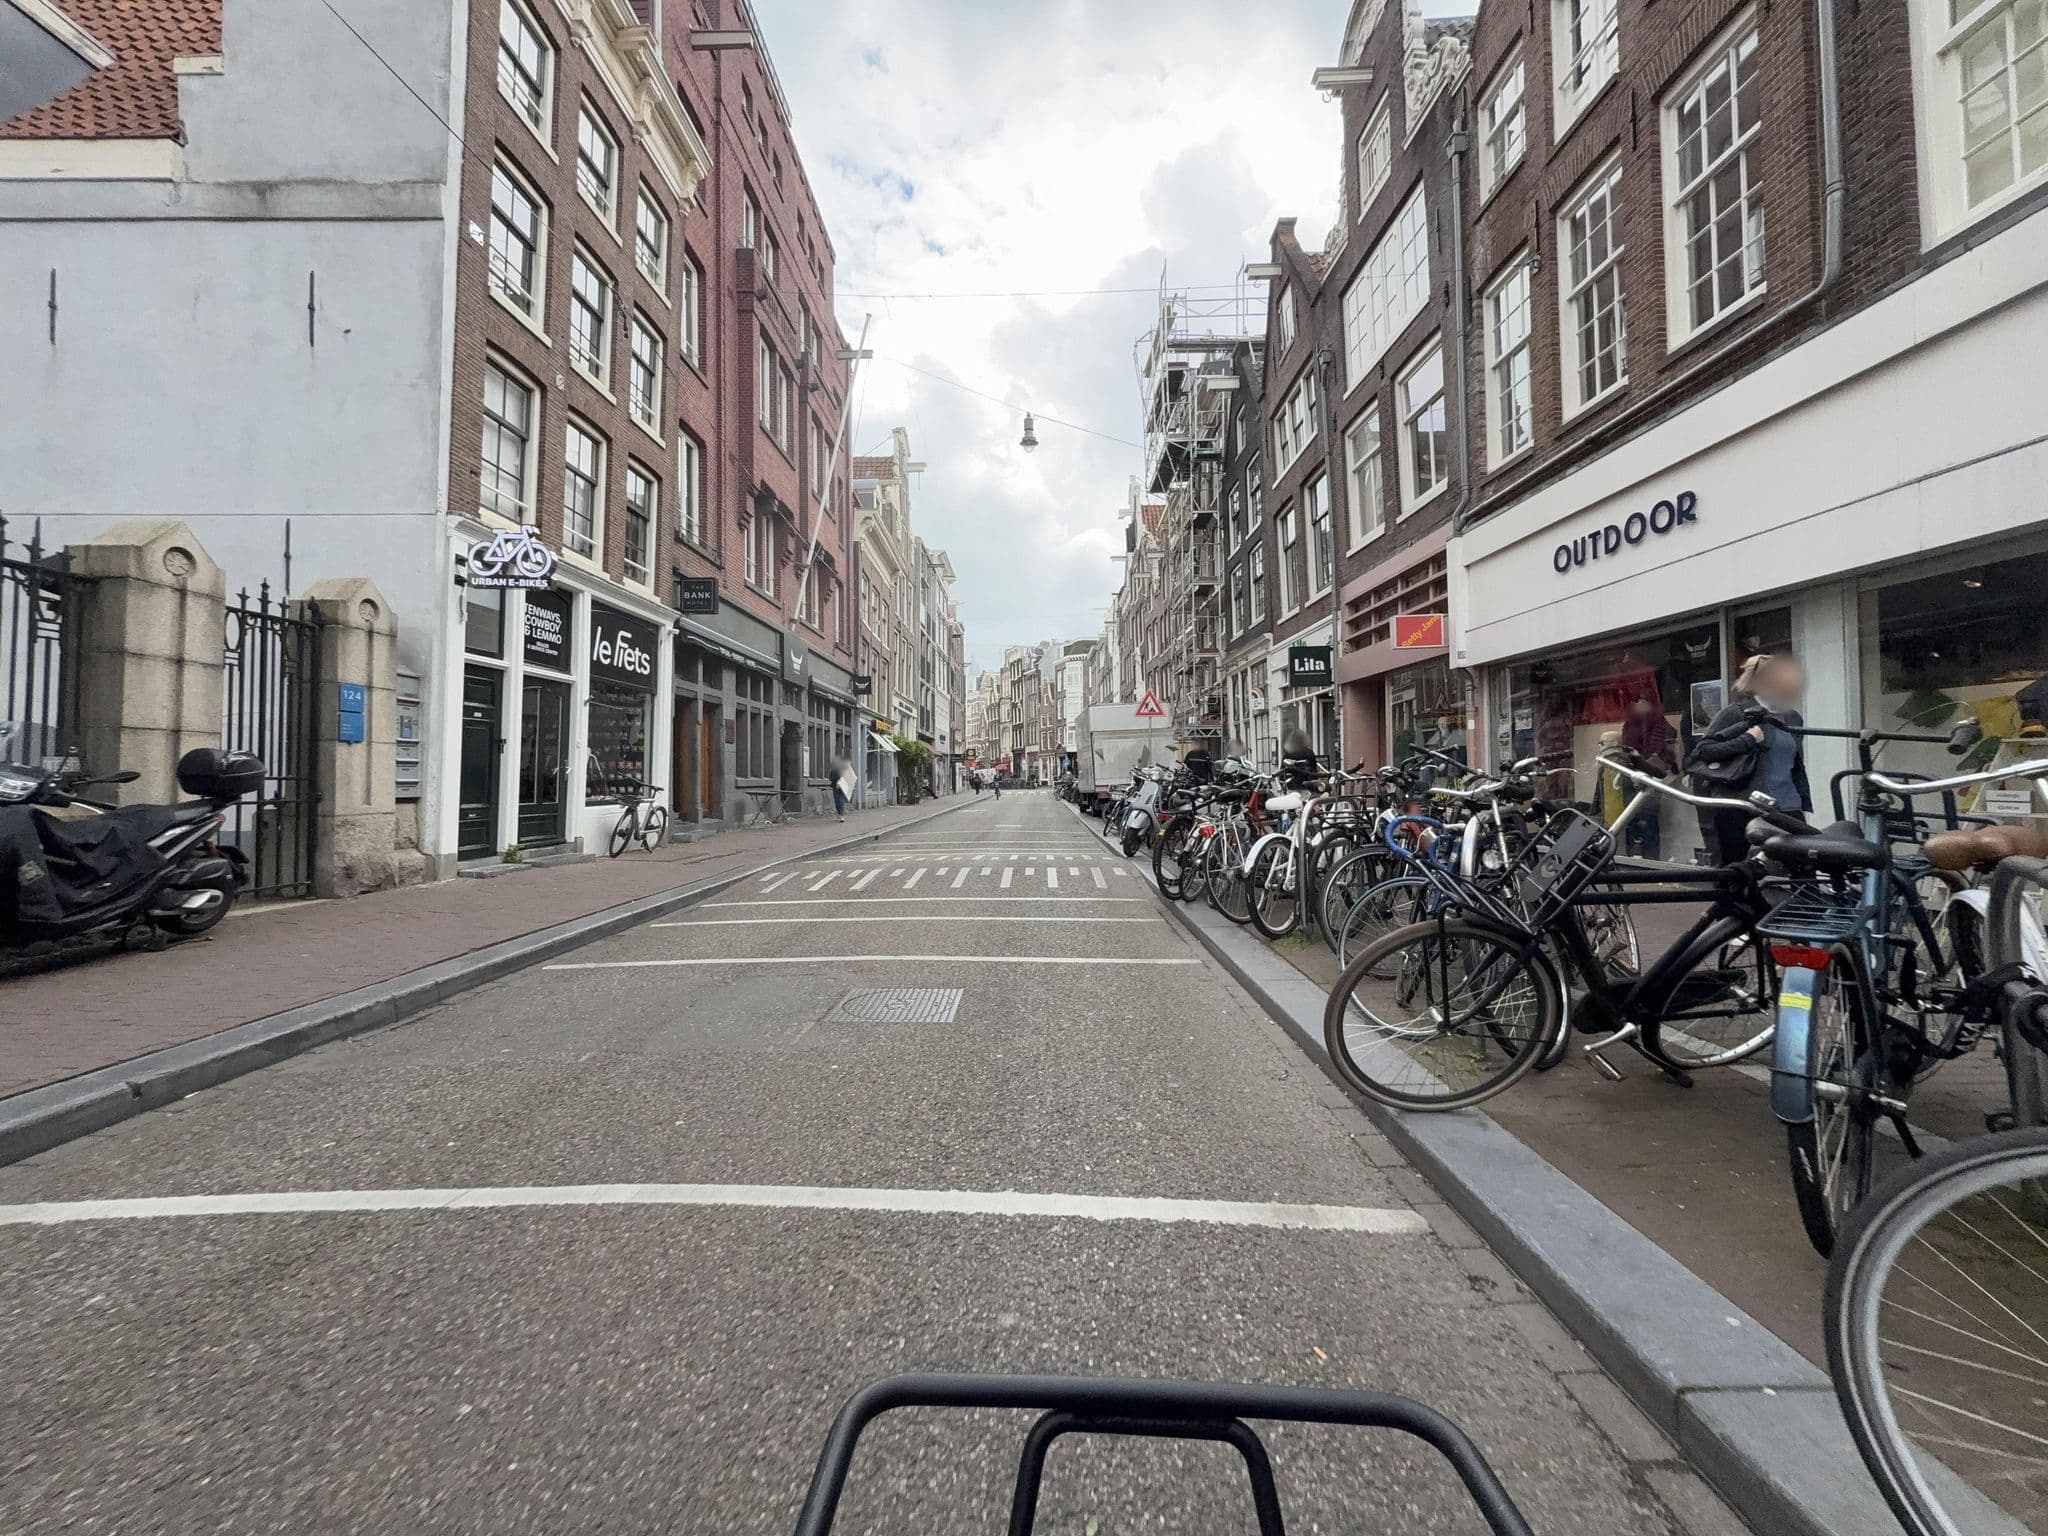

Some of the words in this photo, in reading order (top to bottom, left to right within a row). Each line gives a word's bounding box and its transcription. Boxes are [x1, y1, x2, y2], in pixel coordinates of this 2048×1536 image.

[1553, 490, 1697, 573] OUTDOOR
[471, 577, 506, 586] URBAN
[508, 579, 548, 587] E-BIKES
[683, 591, 711, 599] BANK
[525, 614, 562, 633] COWBOY
[532, 628, 562, 644] LEMMO
[1401, 629, 1423, 647] Betty
[592, 625, 612, 665] le
[613, 630, 651, 675] Fiets
[1294, 657, 1325, 672] Lila
[344, 690, 361, 701] 124
